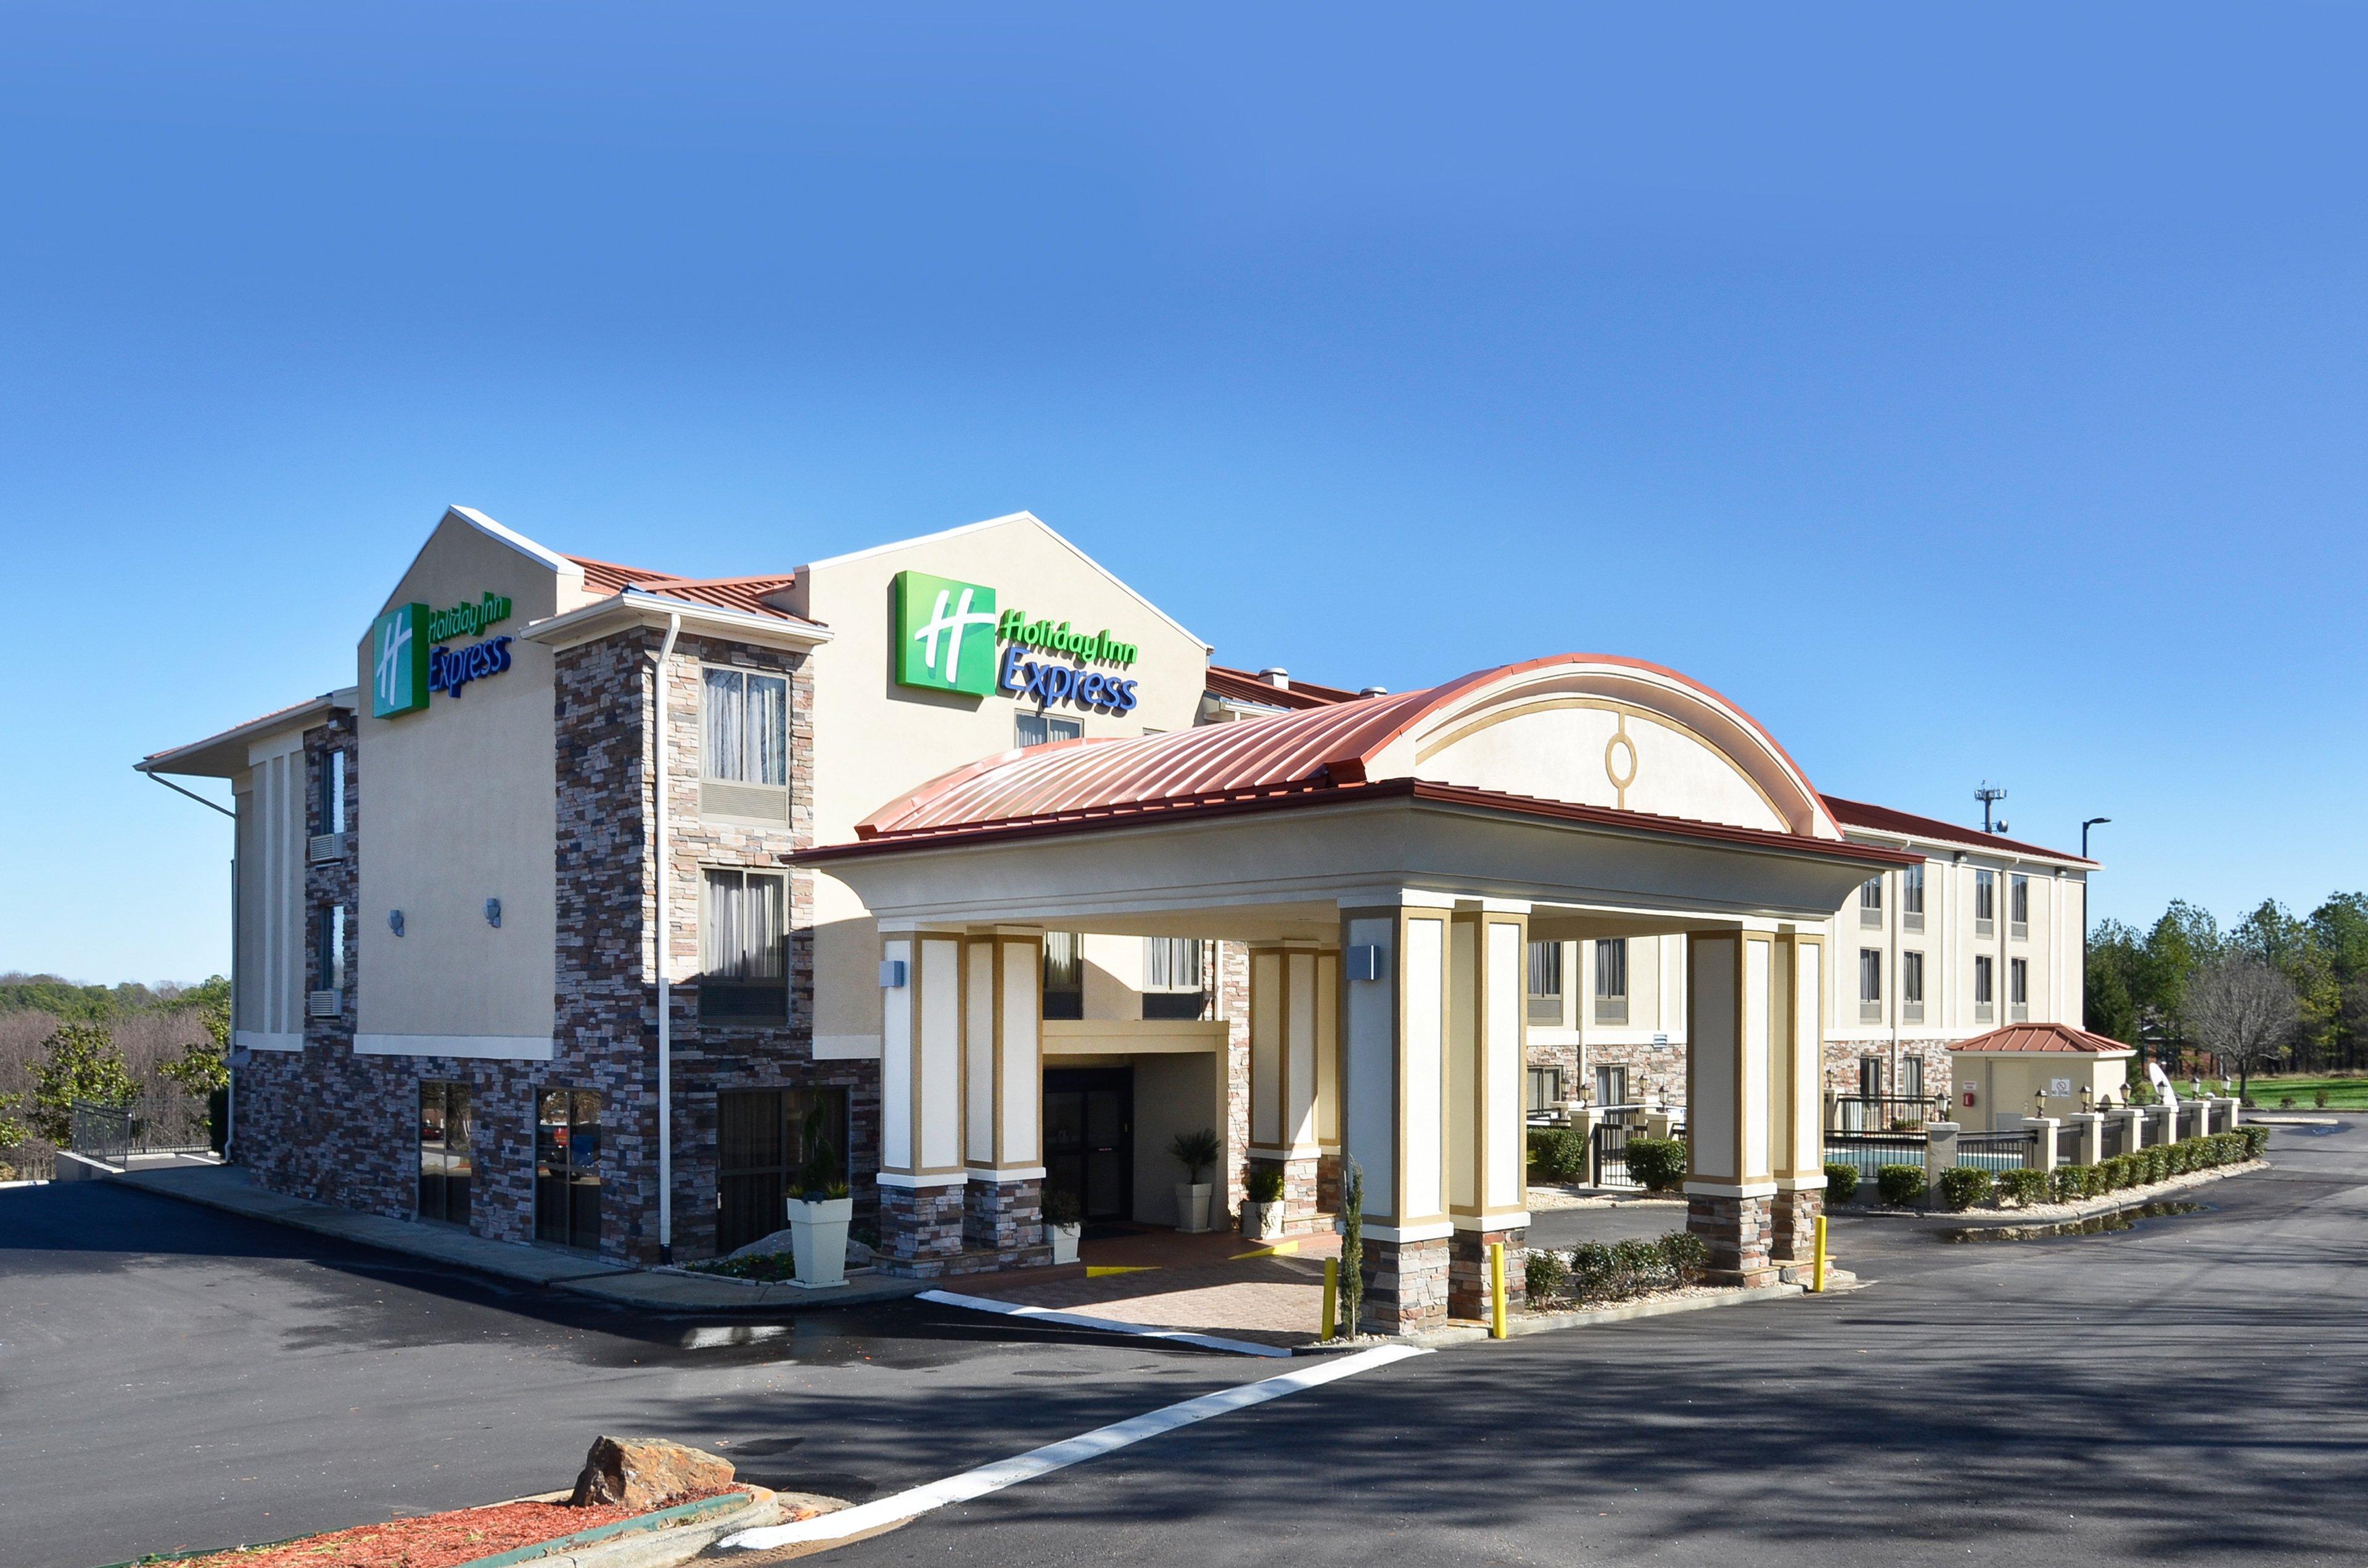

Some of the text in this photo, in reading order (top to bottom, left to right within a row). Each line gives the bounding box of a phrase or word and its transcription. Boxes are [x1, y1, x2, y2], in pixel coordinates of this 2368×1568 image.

[428, 591, 510, 644] Holiday Inn
[999, 609, 1138, 664] Holiday Inn
[428, 636, 513, 698] Express
[1001, 646, 1138, 710] Express
